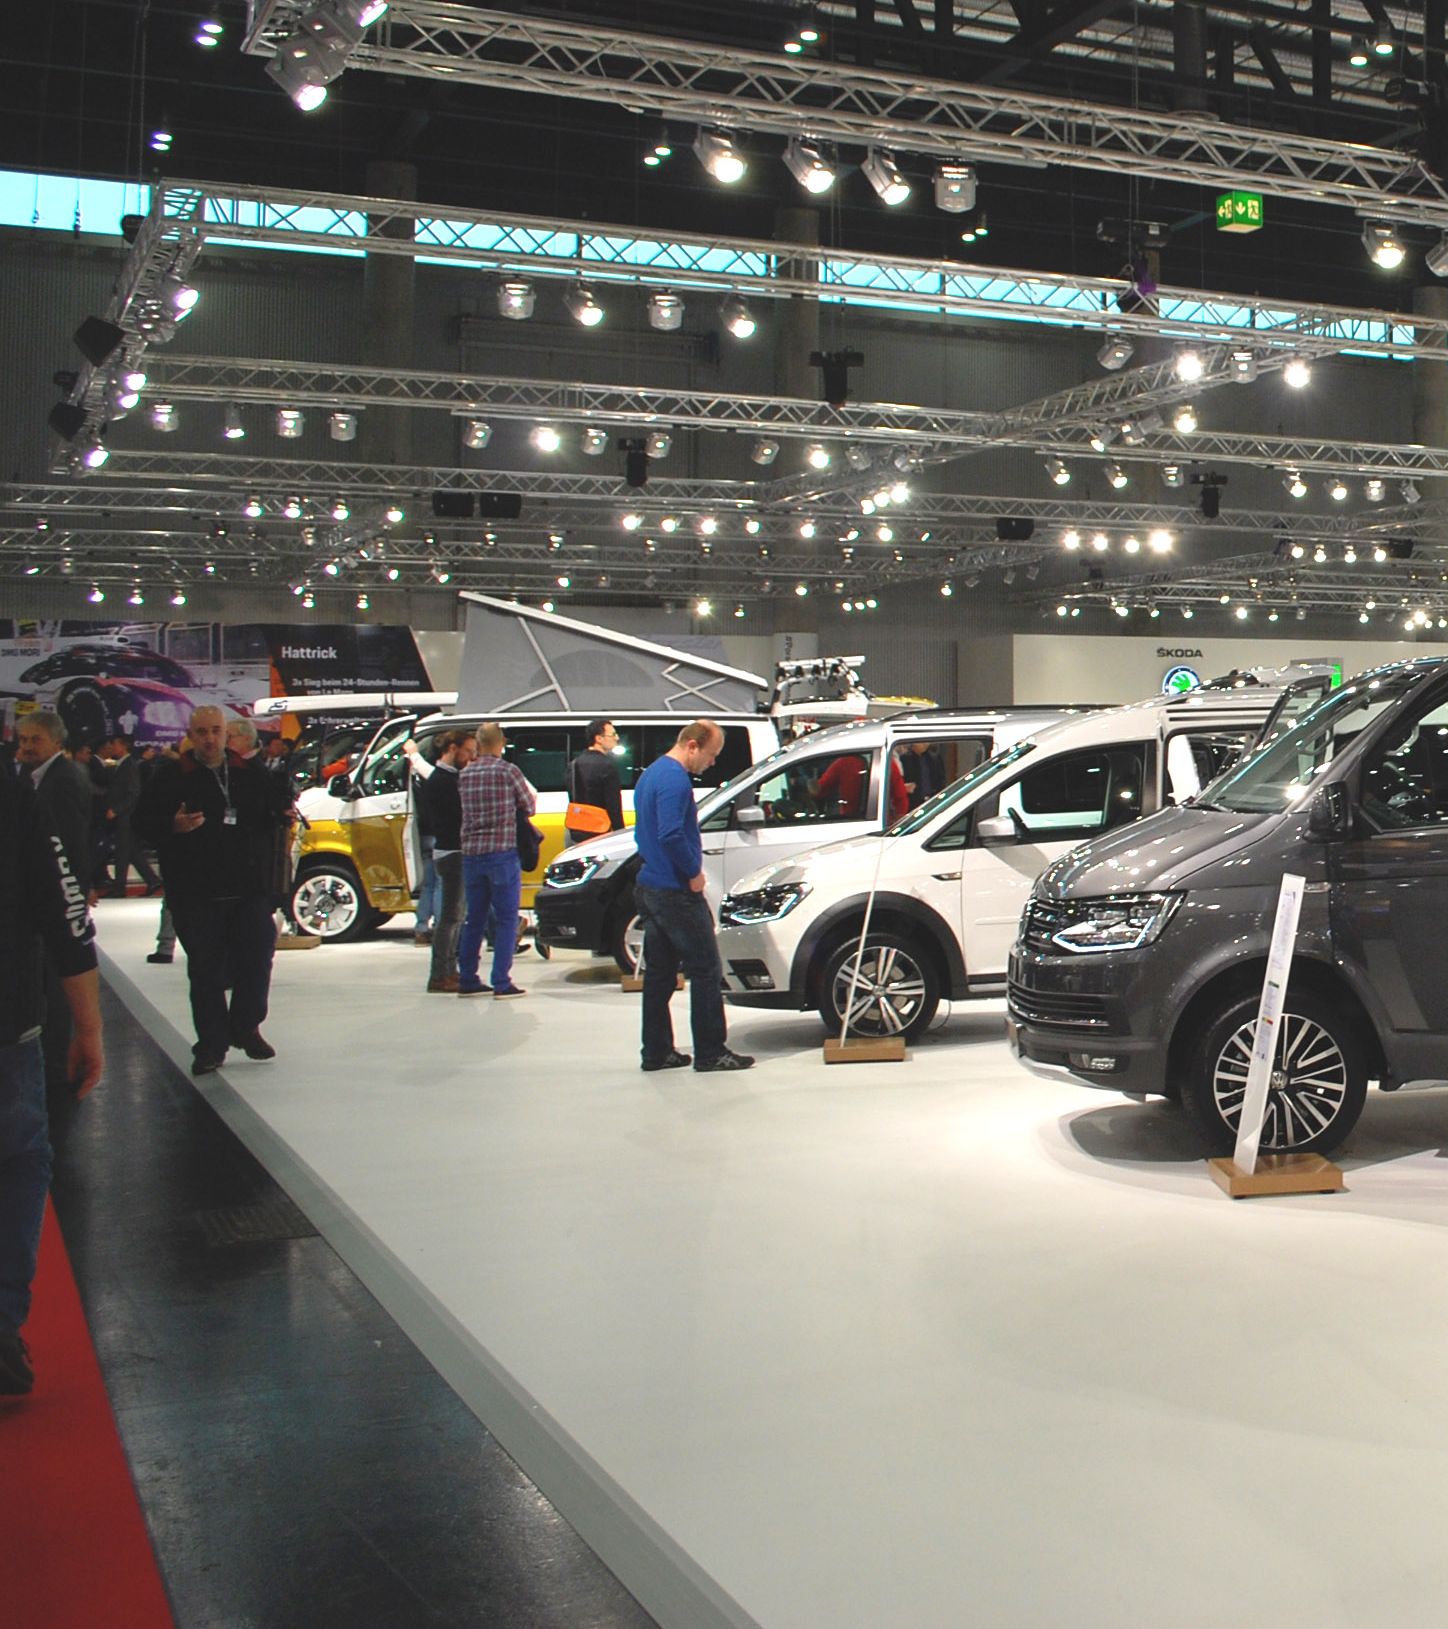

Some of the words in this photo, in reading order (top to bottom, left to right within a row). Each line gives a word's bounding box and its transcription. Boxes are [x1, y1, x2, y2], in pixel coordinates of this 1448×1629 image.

[281, 646, 338, 659] Hattrick
[303, 678, 321, 688] Sieg
[322, 678, 342, 686] beim
